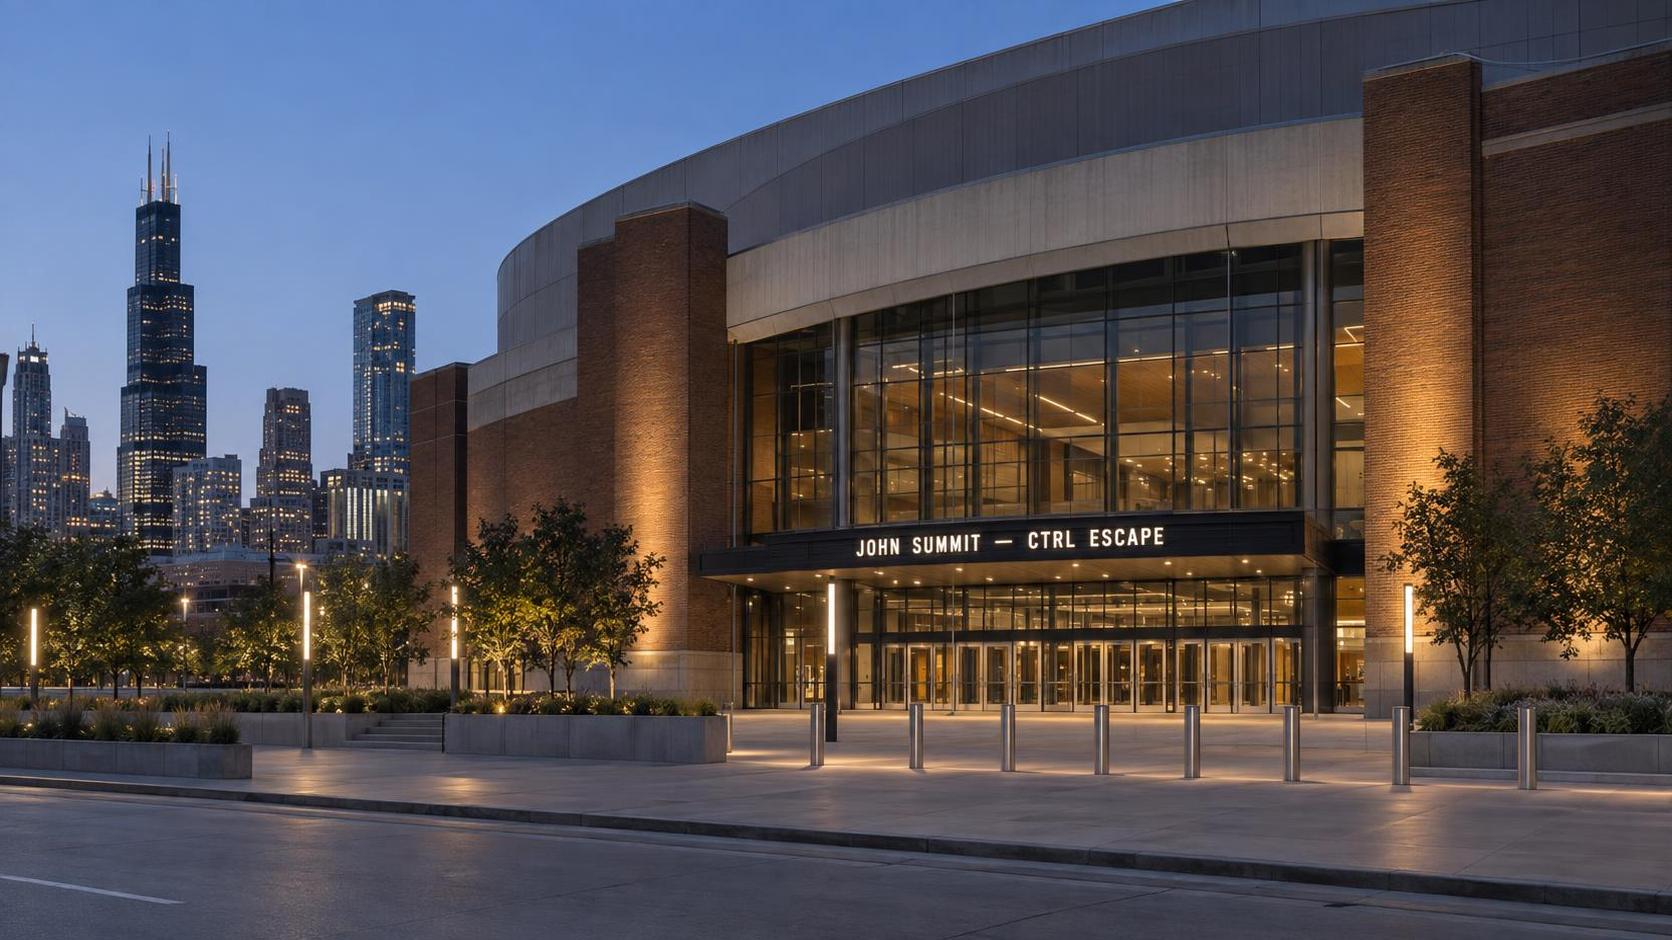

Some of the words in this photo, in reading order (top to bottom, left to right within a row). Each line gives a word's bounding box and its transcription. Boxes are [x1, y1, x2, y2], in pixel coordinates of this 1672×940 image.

[856, 537, 900, 557] JOHN
[912, 533, 981, 554] SUMMIT
[1028, 530, 1076, 549] CTRL
[1089, 527, 1164, 547] ESCAPE
